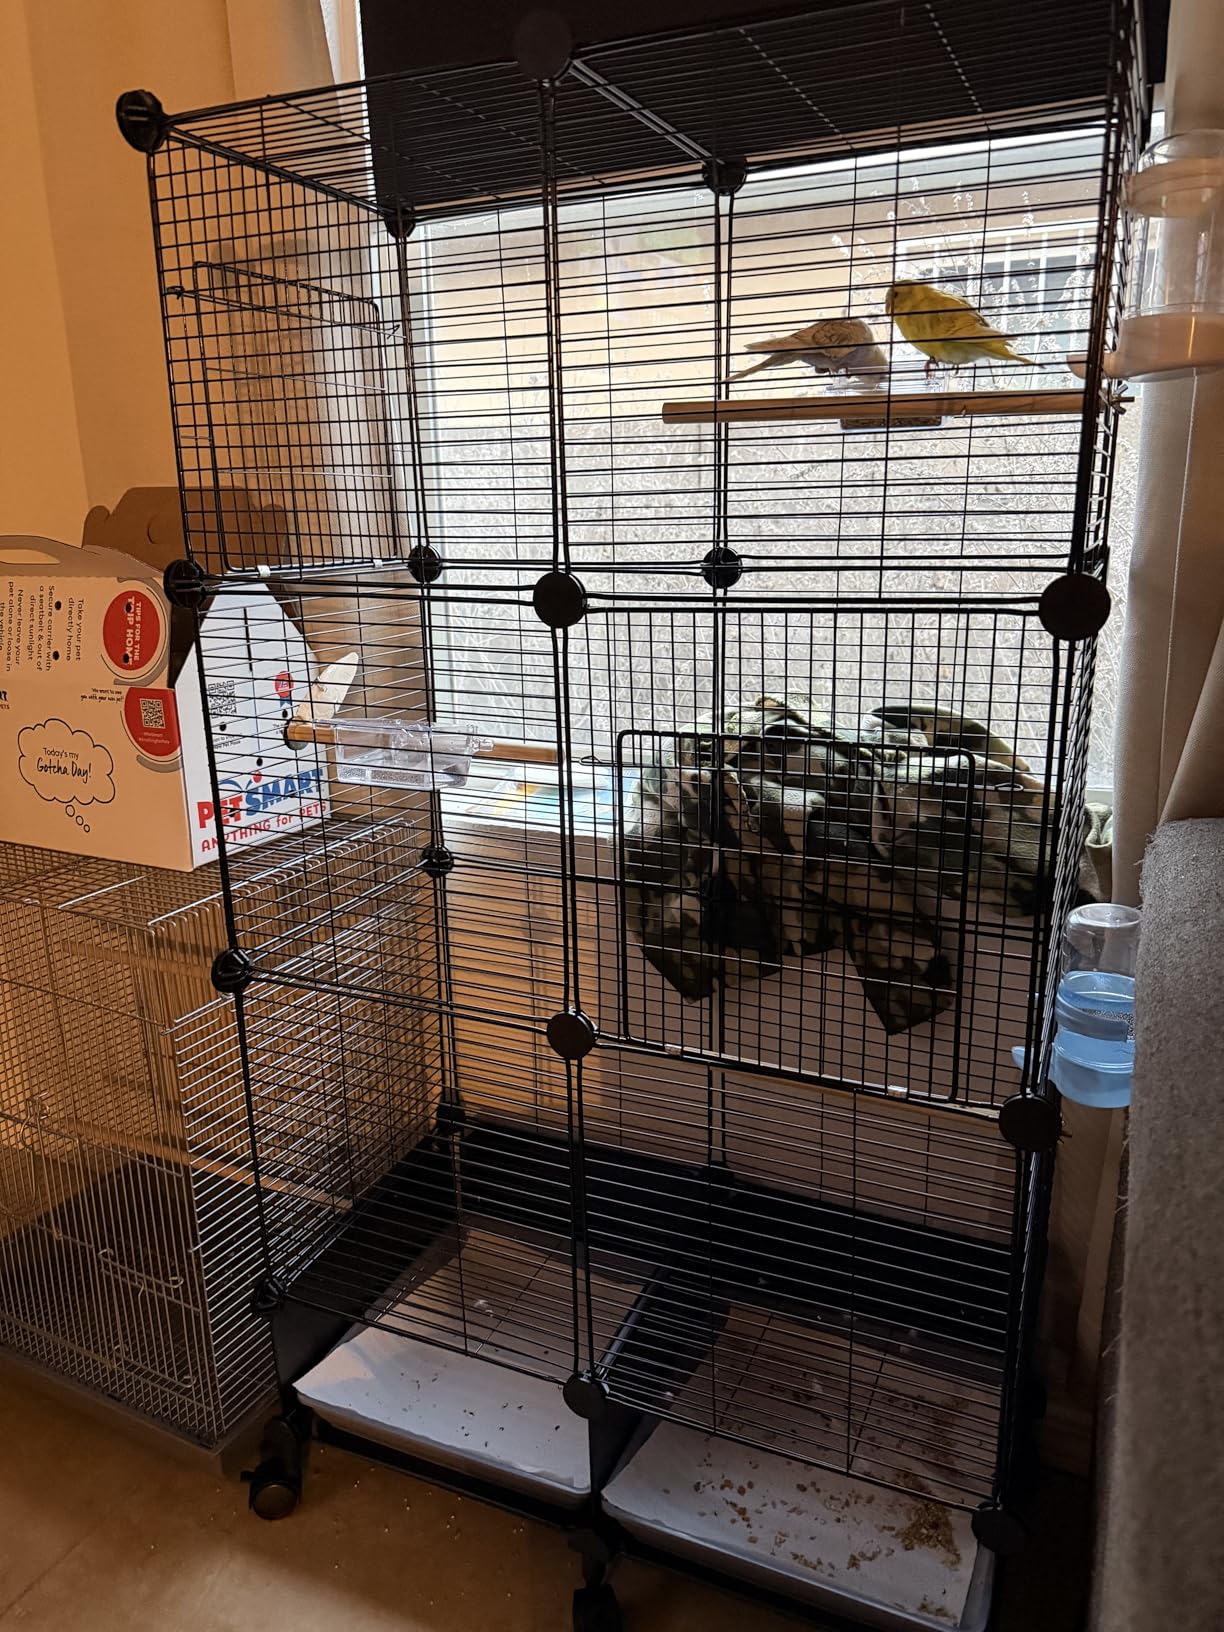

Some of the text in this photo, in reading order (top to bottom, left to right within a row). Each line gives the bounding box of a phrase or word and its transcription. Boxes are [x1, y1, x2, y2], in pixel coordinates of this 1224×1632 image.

[66, 597, 75, 633] directly
[7, 626, 13, 637] or
[27, 624, 35, 661] sunlight
[6, 663, 12, 672] in
[36, 660, 42, 671] of
[43, 747, 79, 760] Today's my
[37, 757, 92, 784] Gotcha Day!
[276, 815, 293, 828] for
[299, 801, 326, 818] PETS
